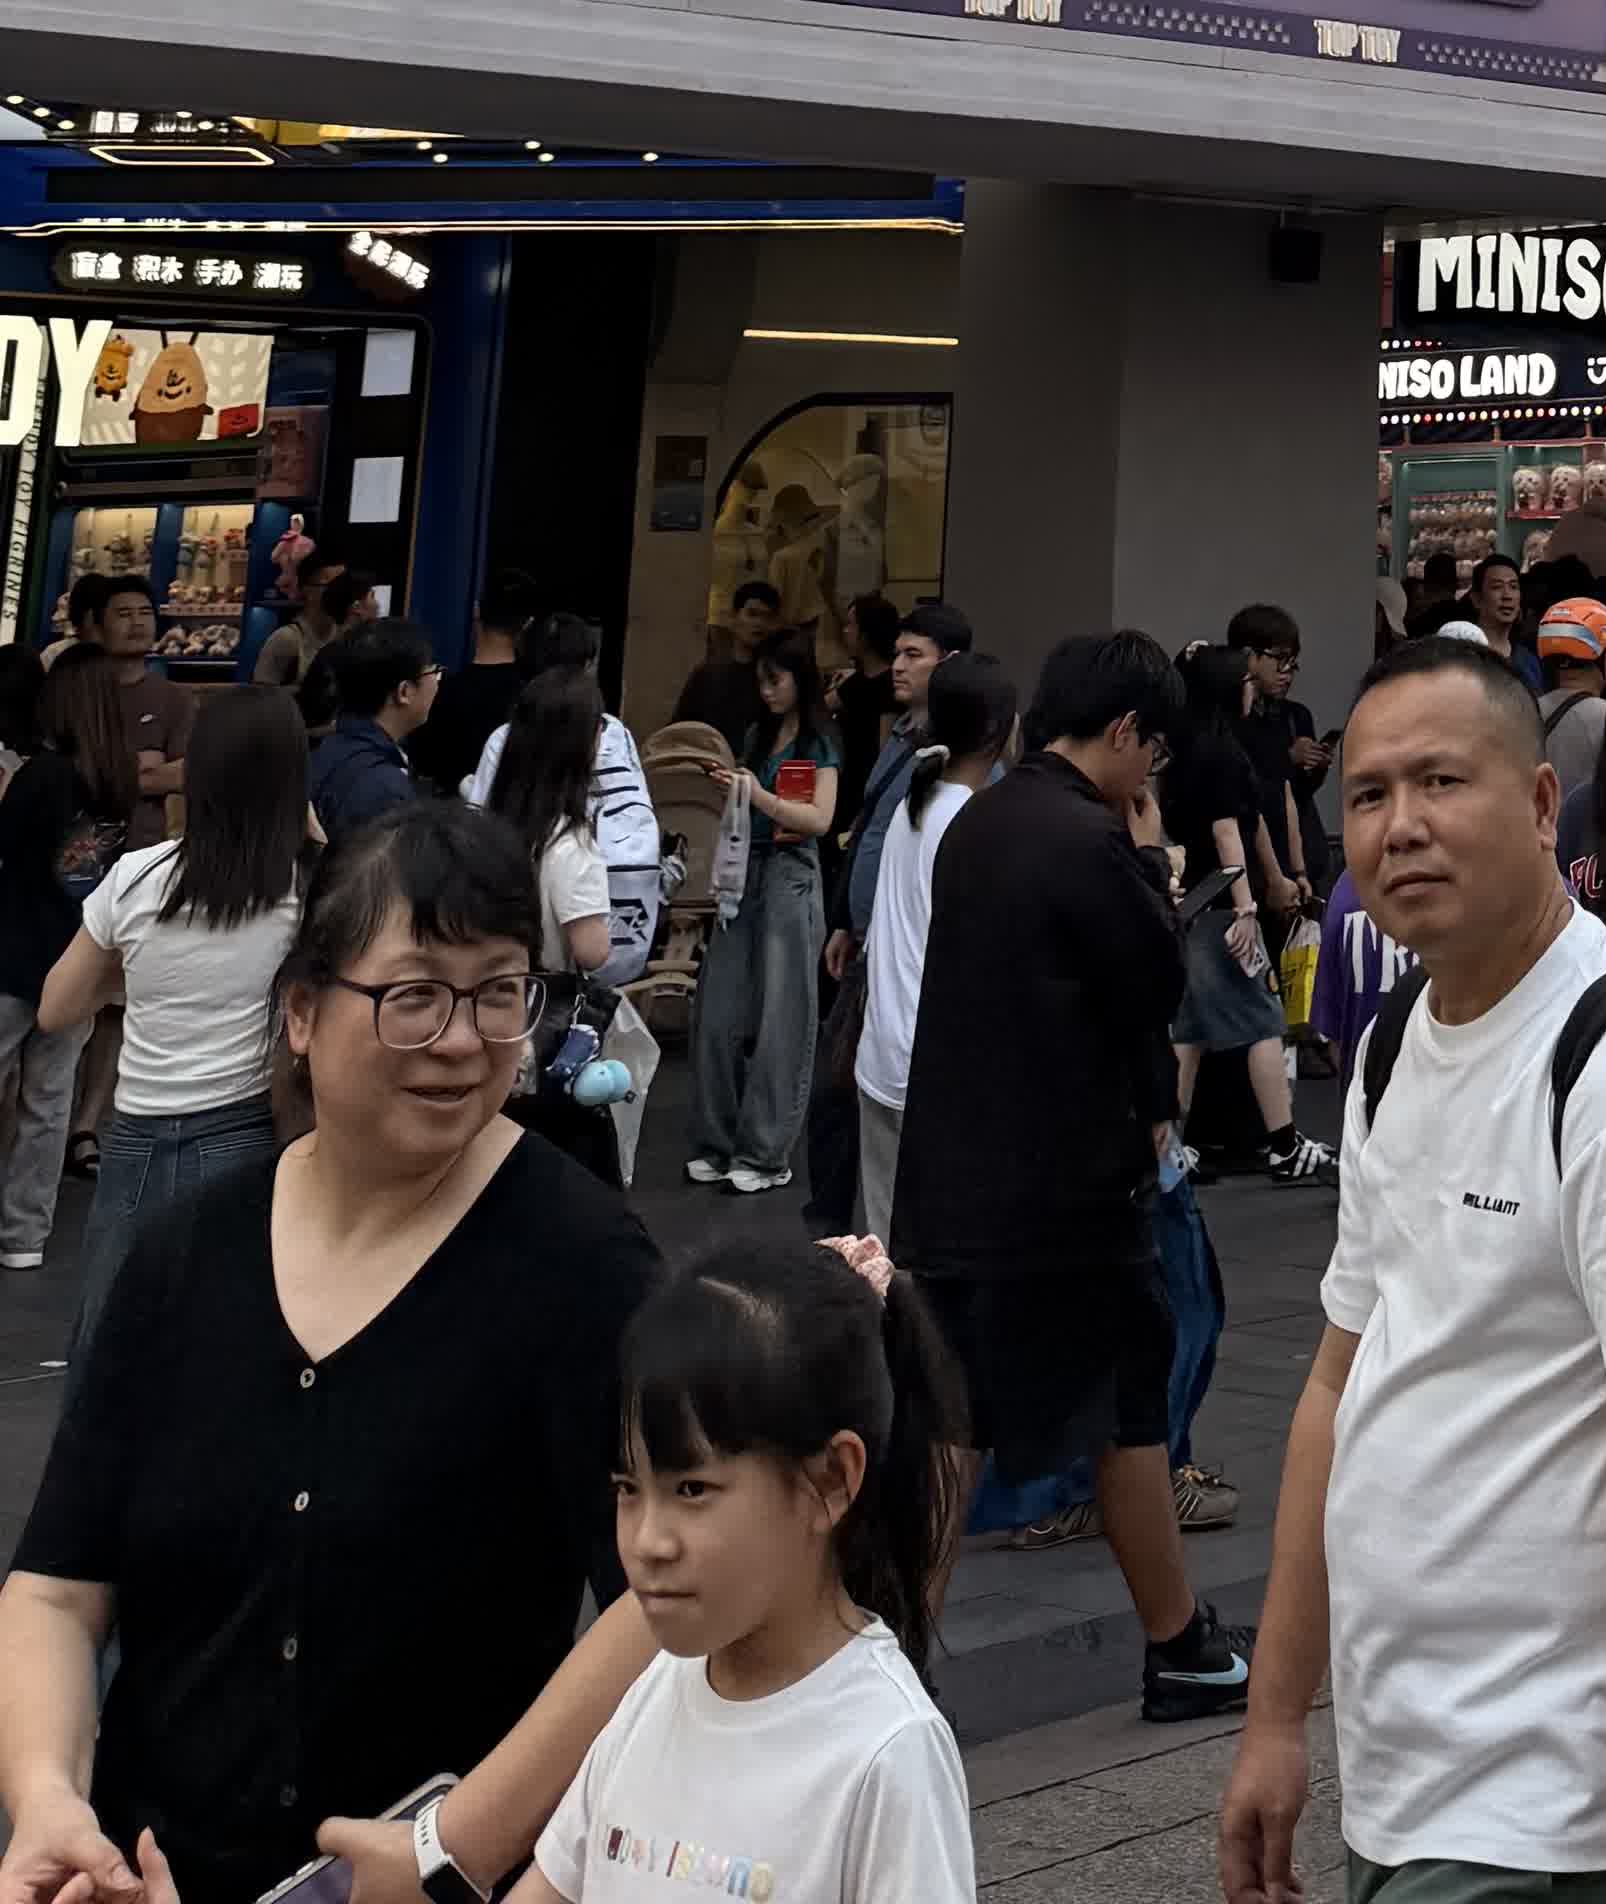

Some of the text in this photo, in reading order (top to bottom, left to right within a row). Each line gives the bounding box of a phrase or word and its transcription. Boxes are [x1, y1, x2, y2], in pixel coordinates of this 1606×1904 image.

[71, 250, 303, 291] 盲盒 积木 手办 潮玩
[1378, 352, 1557, 401] NISO LAND
